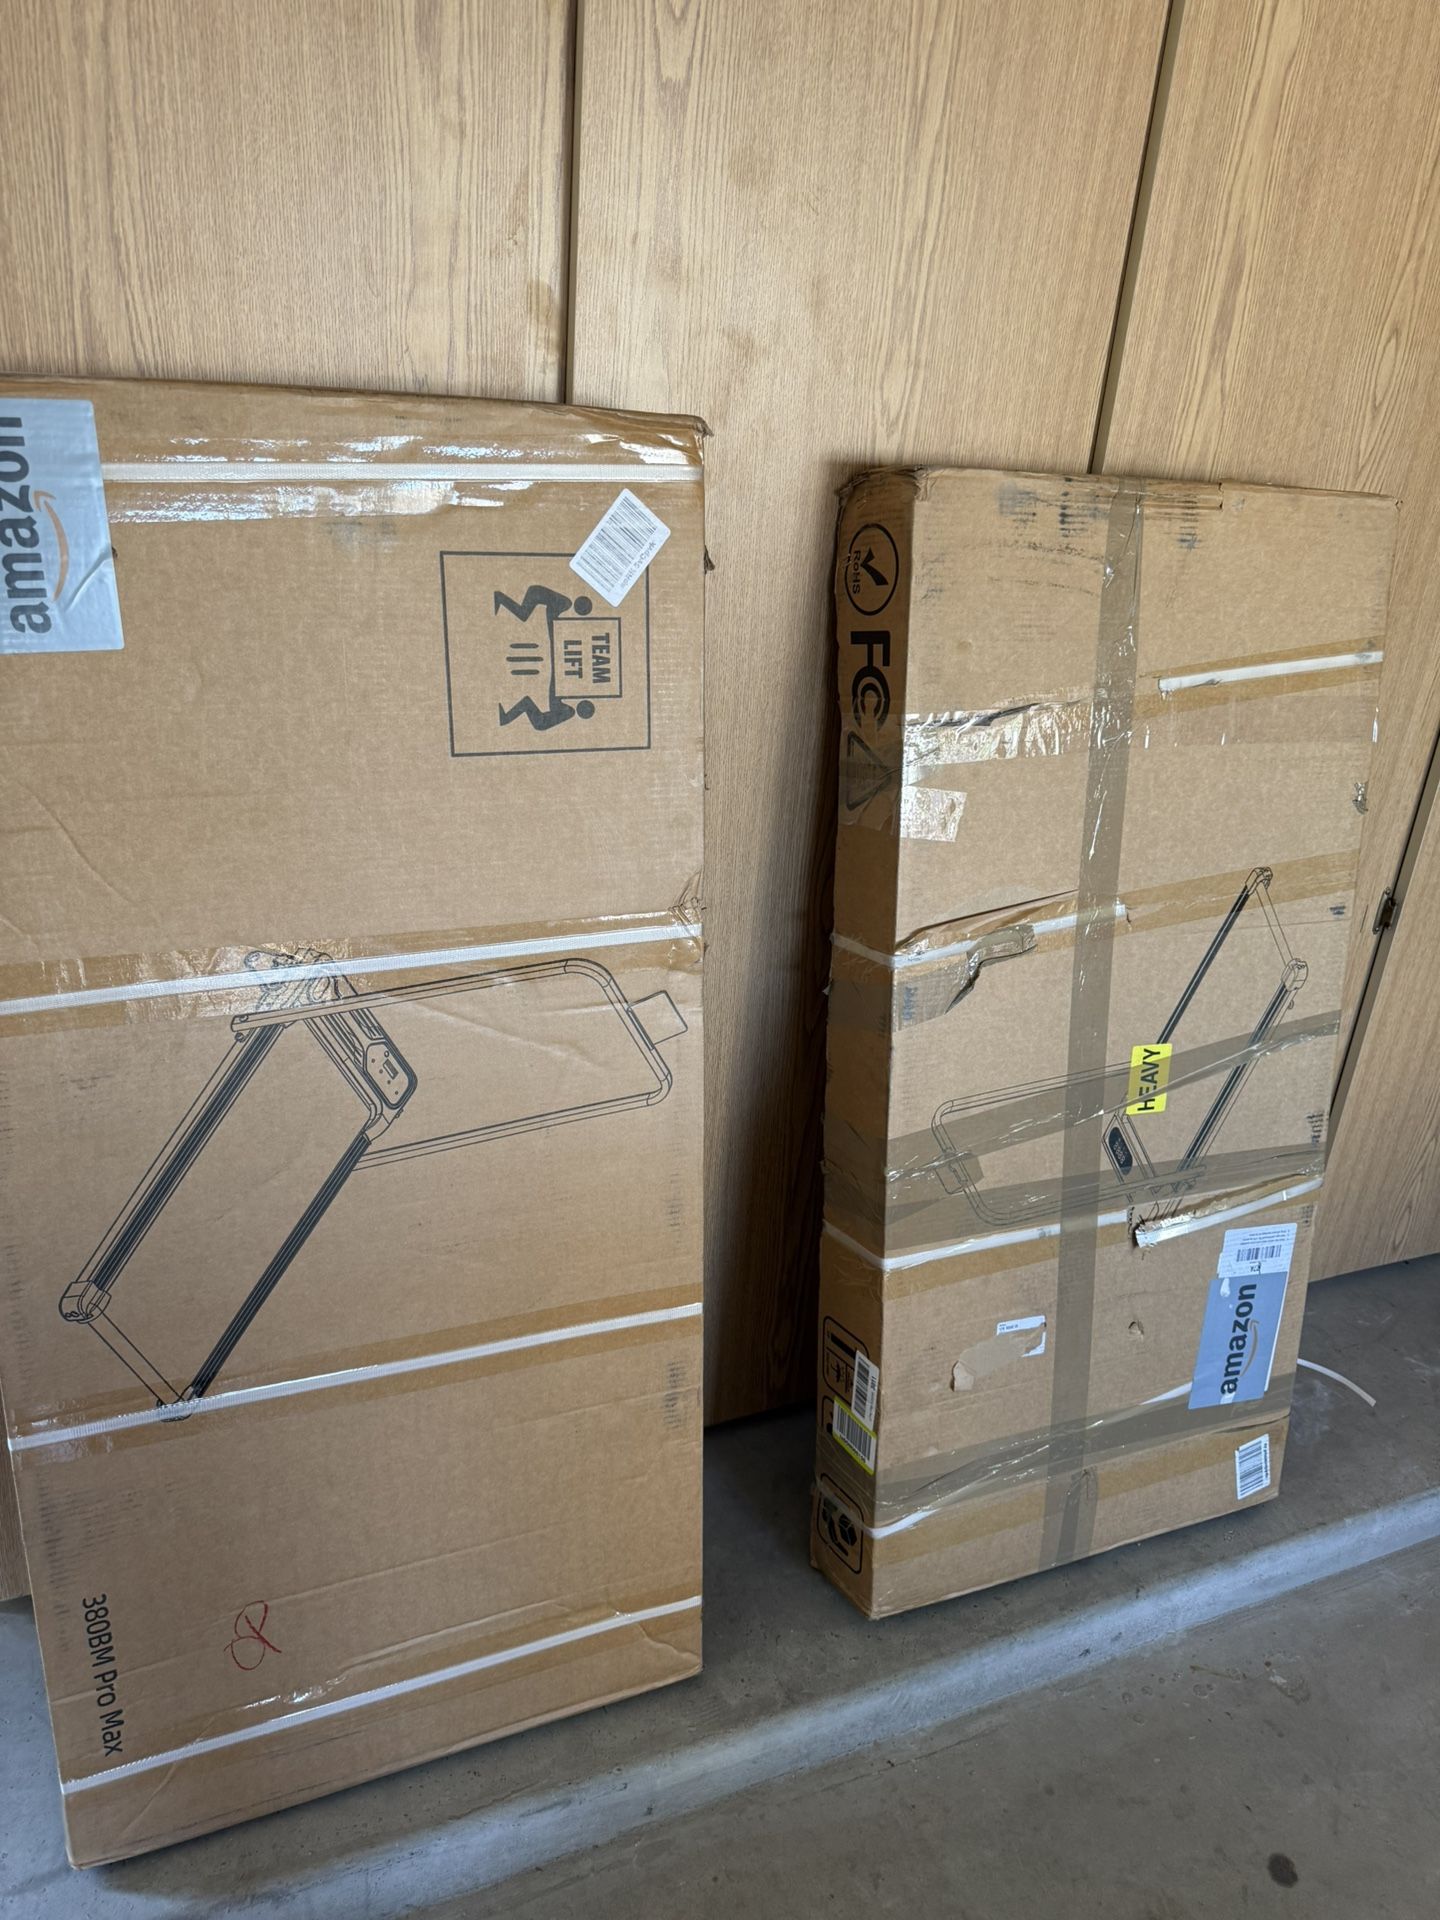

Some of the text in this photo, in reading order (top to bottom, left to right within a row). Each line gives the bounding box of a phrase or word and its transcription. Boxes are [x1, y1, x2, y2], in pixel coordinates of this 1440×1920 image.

[852, 549, 861, 595] RoHS
[563, 640, 583, 679] LIFT
[592, 632, 611, 684] TEAM
[1137, 1047, 1161, 1112] HEAVY
[1220, 1283, 1257, 1395] amazon
[82, 1593, 125, 1757] 380BM Pro Max
